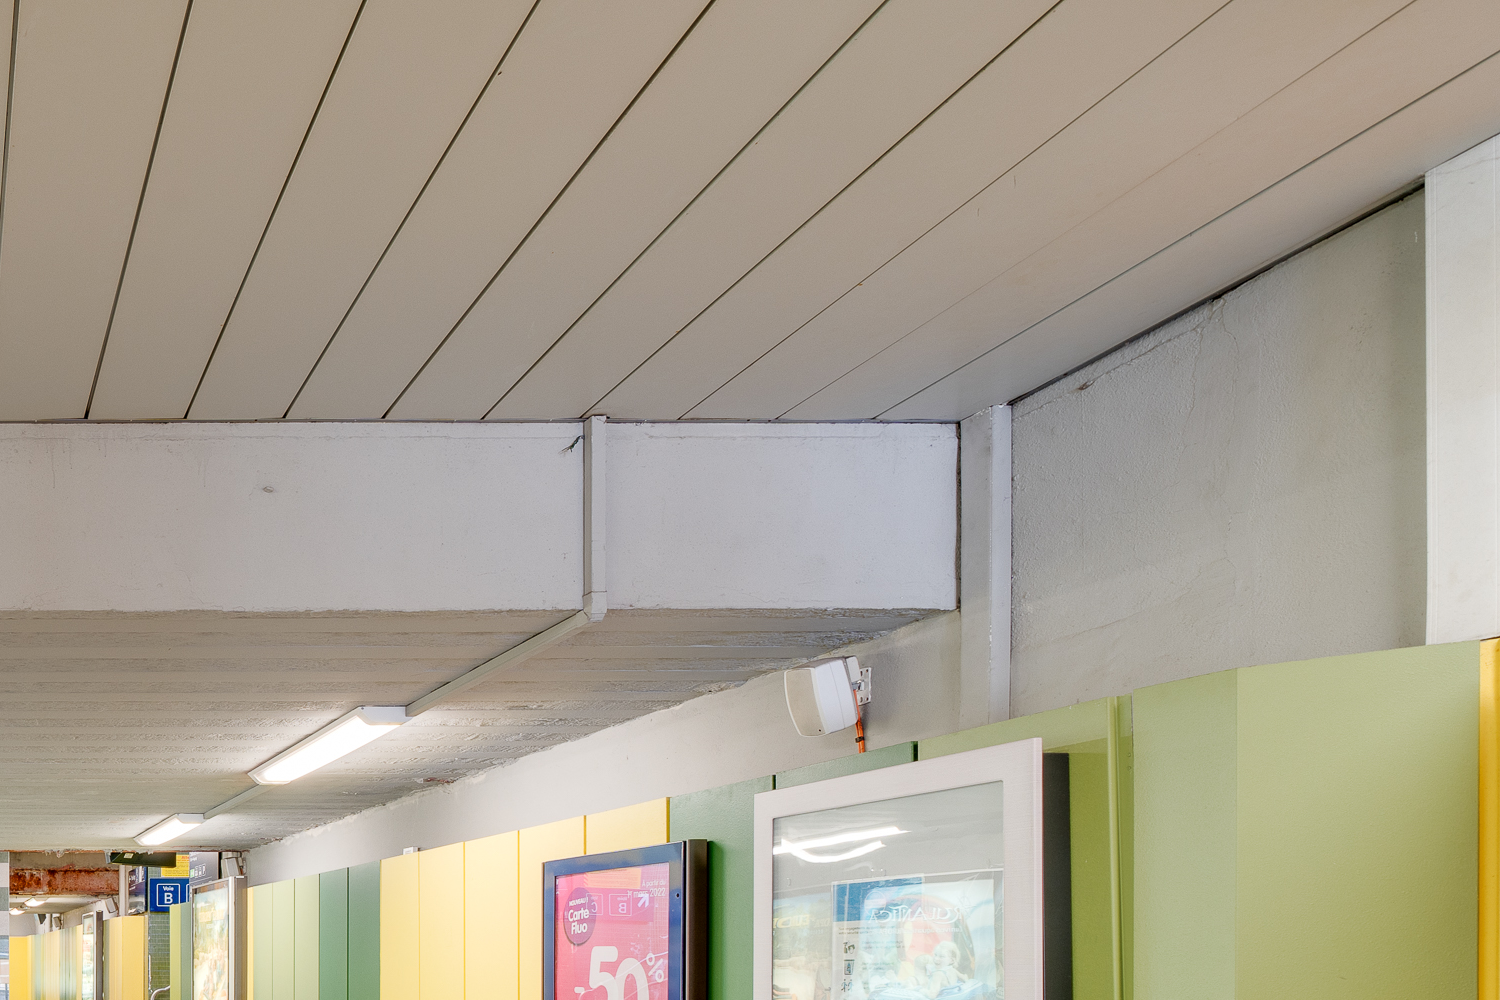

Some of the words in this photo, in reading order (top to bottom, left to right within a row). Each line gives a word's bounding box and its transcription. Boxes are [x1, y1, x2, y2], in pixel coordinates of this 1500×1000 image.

[164, 892, 173, 904] B
[650, 888, 666, 897] 2022
[569, 898, 586, 907] NOUVEAU
[568, 908, 589, 921] Carte
[571, 921, 588, 934] Fluo
